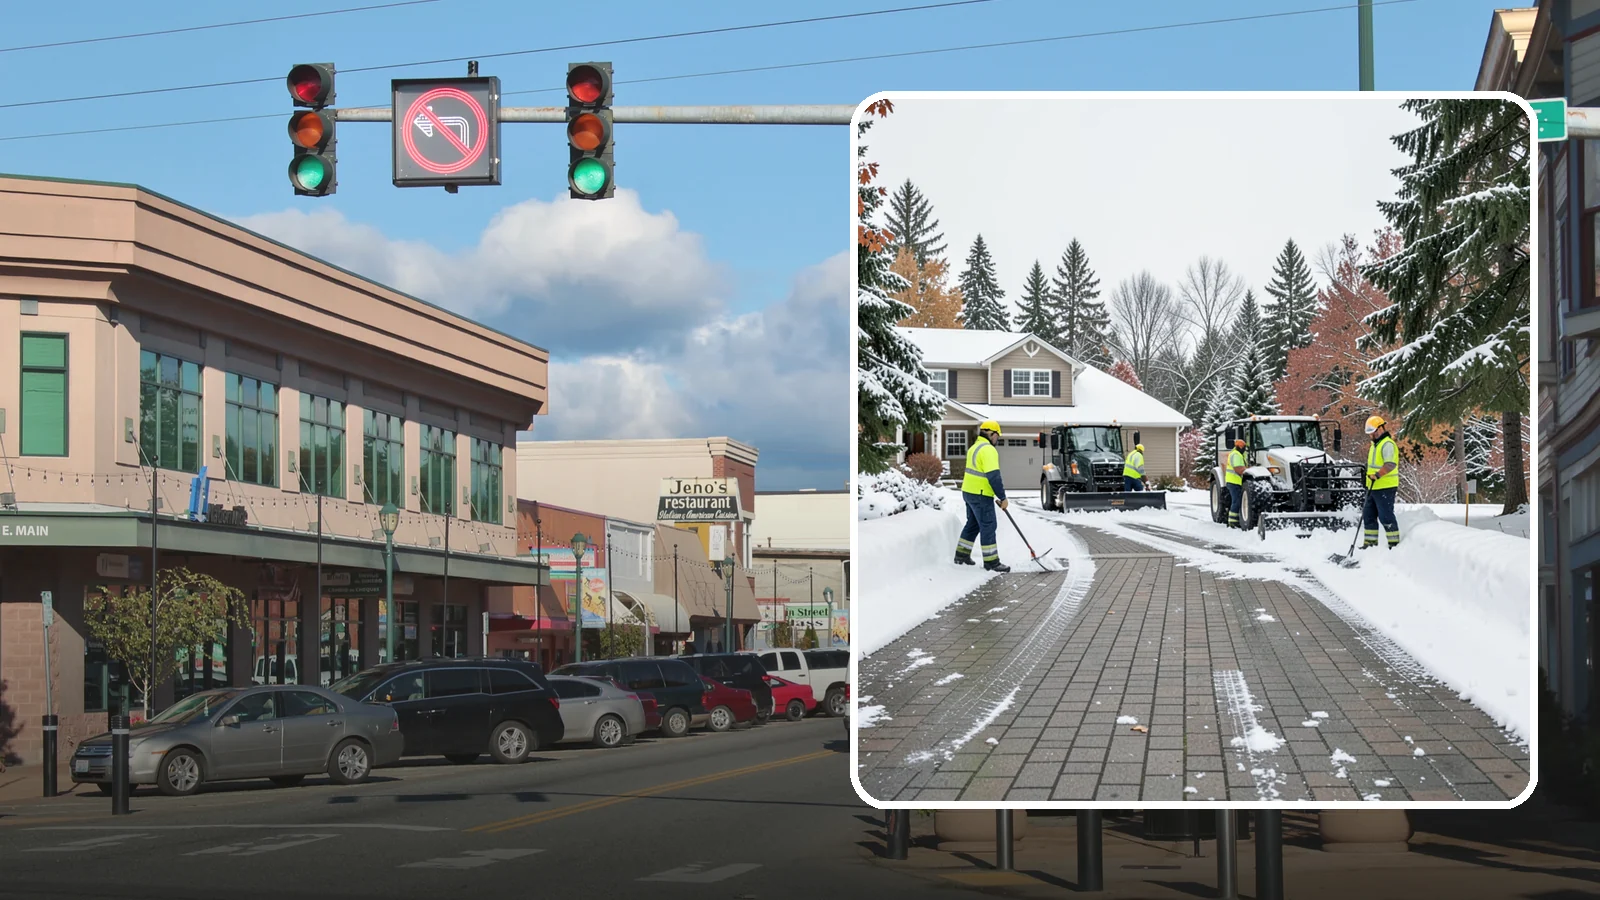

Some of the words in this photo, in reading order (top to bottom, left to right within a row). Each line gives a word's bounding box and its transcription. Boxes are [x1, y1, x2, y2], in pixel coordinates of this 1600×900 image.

[670, 480, 728, 495] Jeno's
[665, 496, 731, 509] restaurant
[658, 510, 681, 520] Italian
[686, 510, 714, 519] American
[715, 510, 738, 519] Cuisine
[2, 525, 13, 536] E.
[15, 525, 49, 536] MAIN
[798, 607, 828, 617] Street
